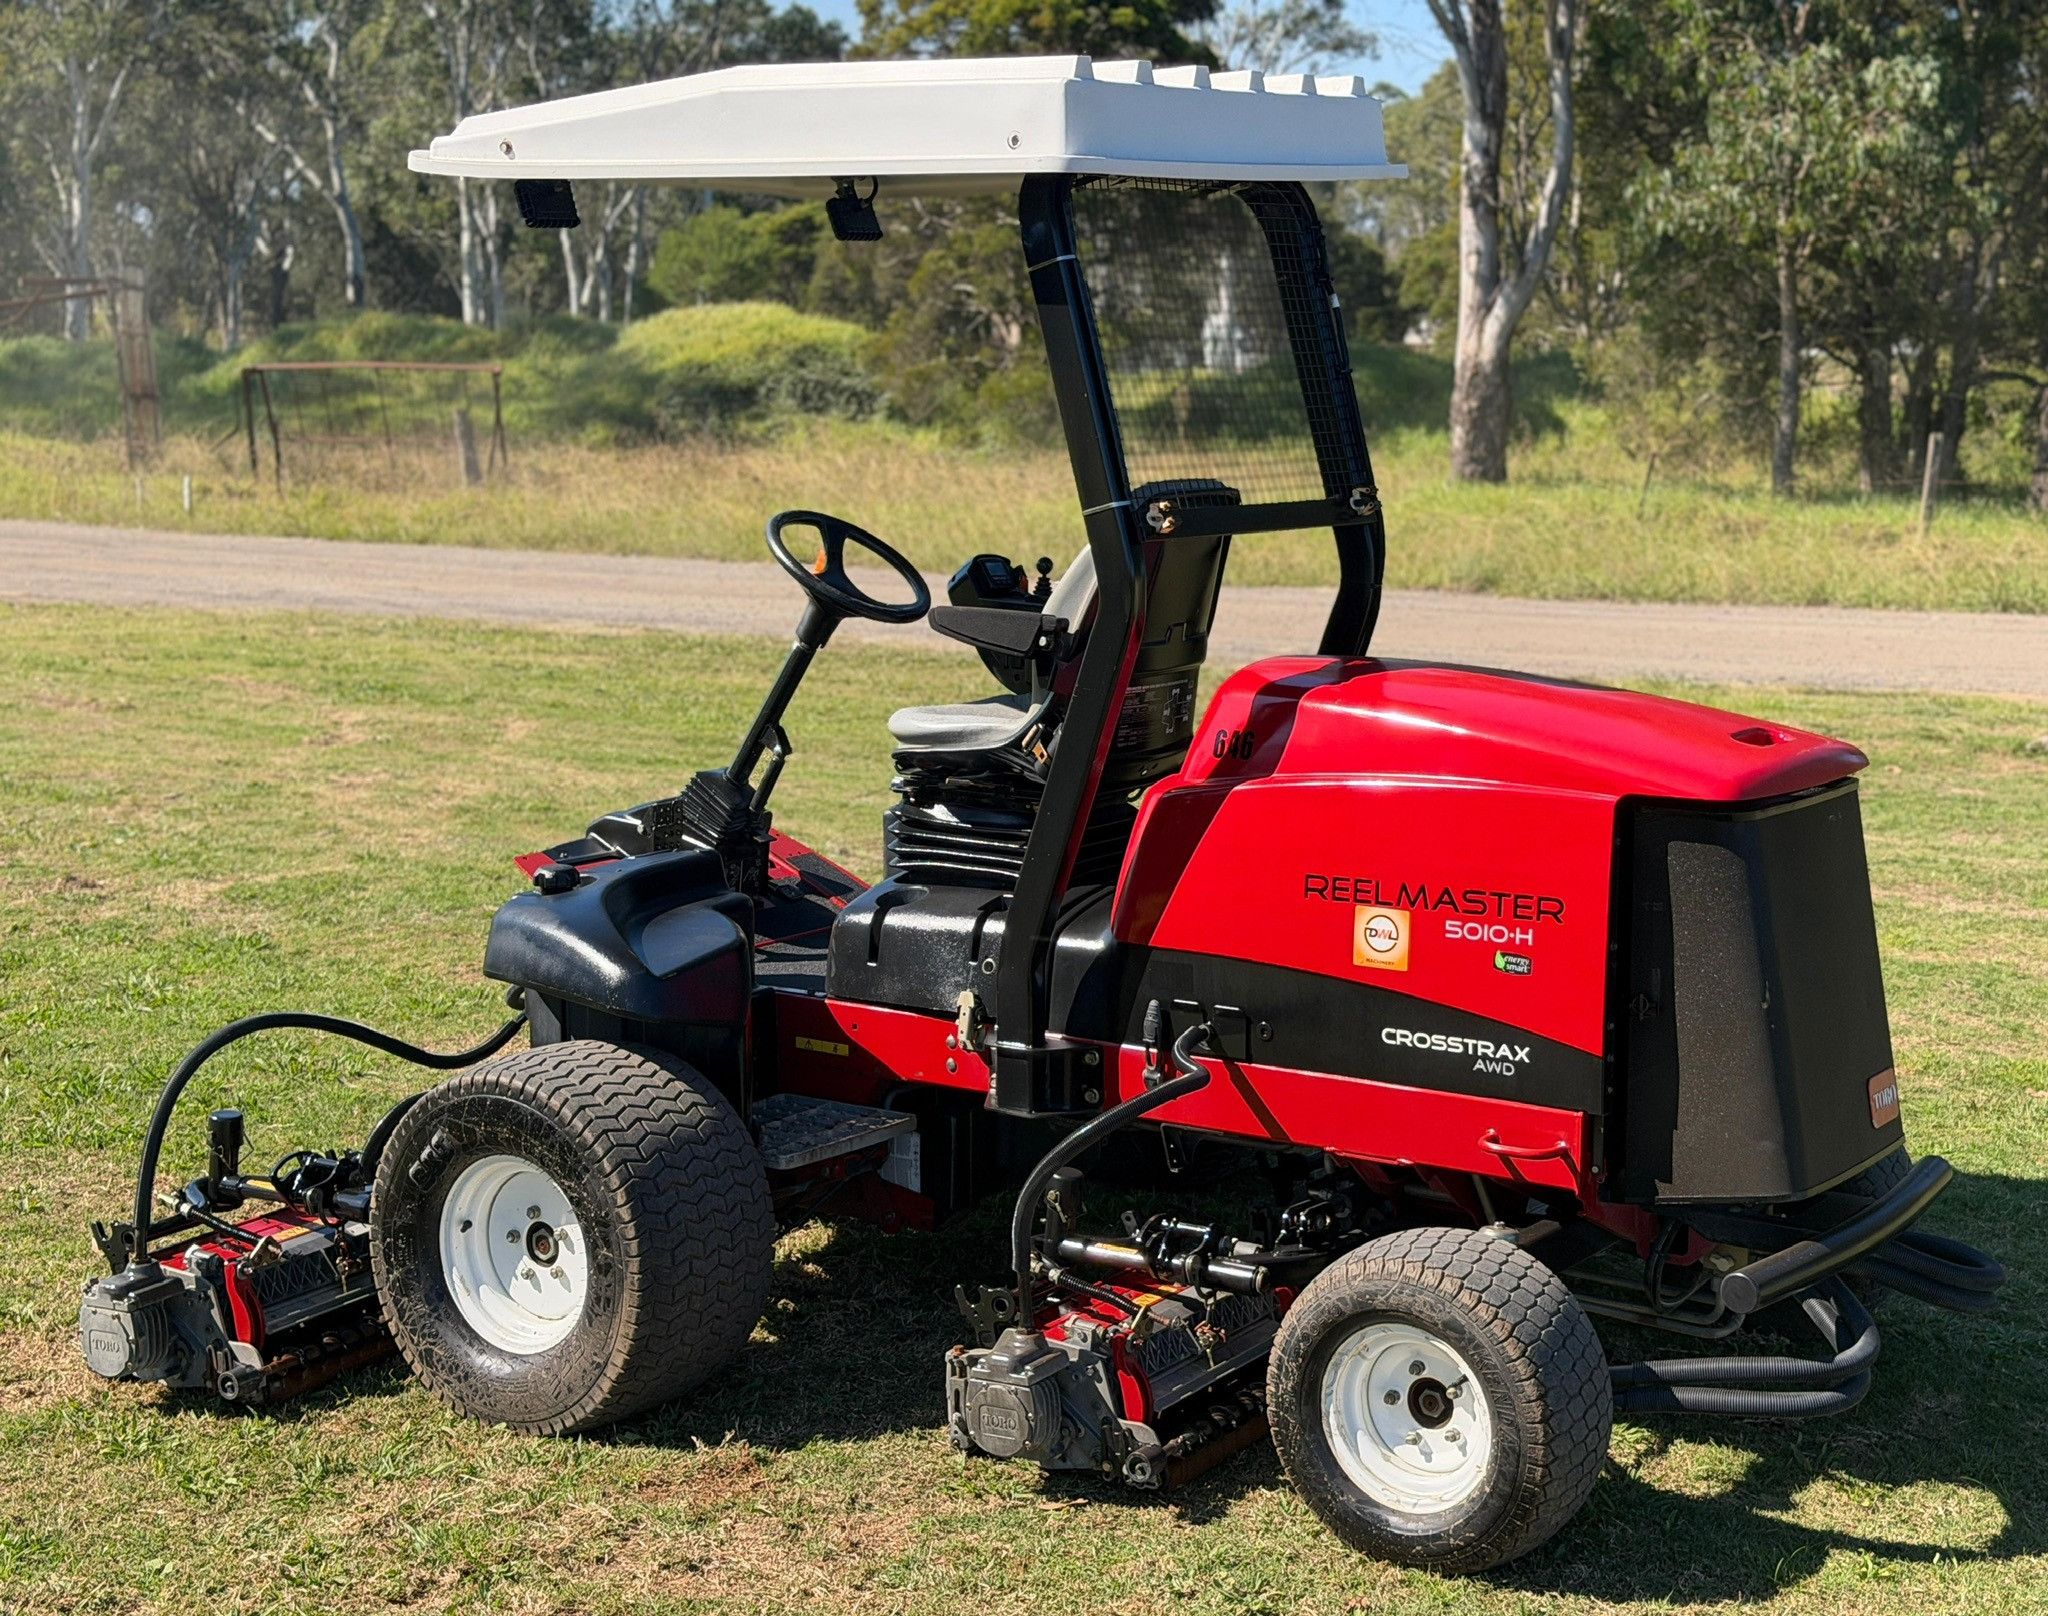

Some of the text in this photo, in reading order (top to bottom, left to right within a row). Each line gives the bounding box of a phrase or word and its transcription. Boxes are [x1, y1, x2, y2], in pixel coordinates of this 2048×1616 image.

[1213, 729, 1256, 760] 646
[1304, 873, 1566, 924] REELMASTER
[1366, 927, 1399, 941] DWL
[1504, 956, 1530, 966] energy
[1381, 1027, 1531, 1063] CROSSTRAX
[1472, 1058, 1516, 1076] AWD
[1872, 1084, 1897, 1110] TORO
[92, 1339, 120, 1353] TORO
[982, 1413, 1017, 1430] TORO
